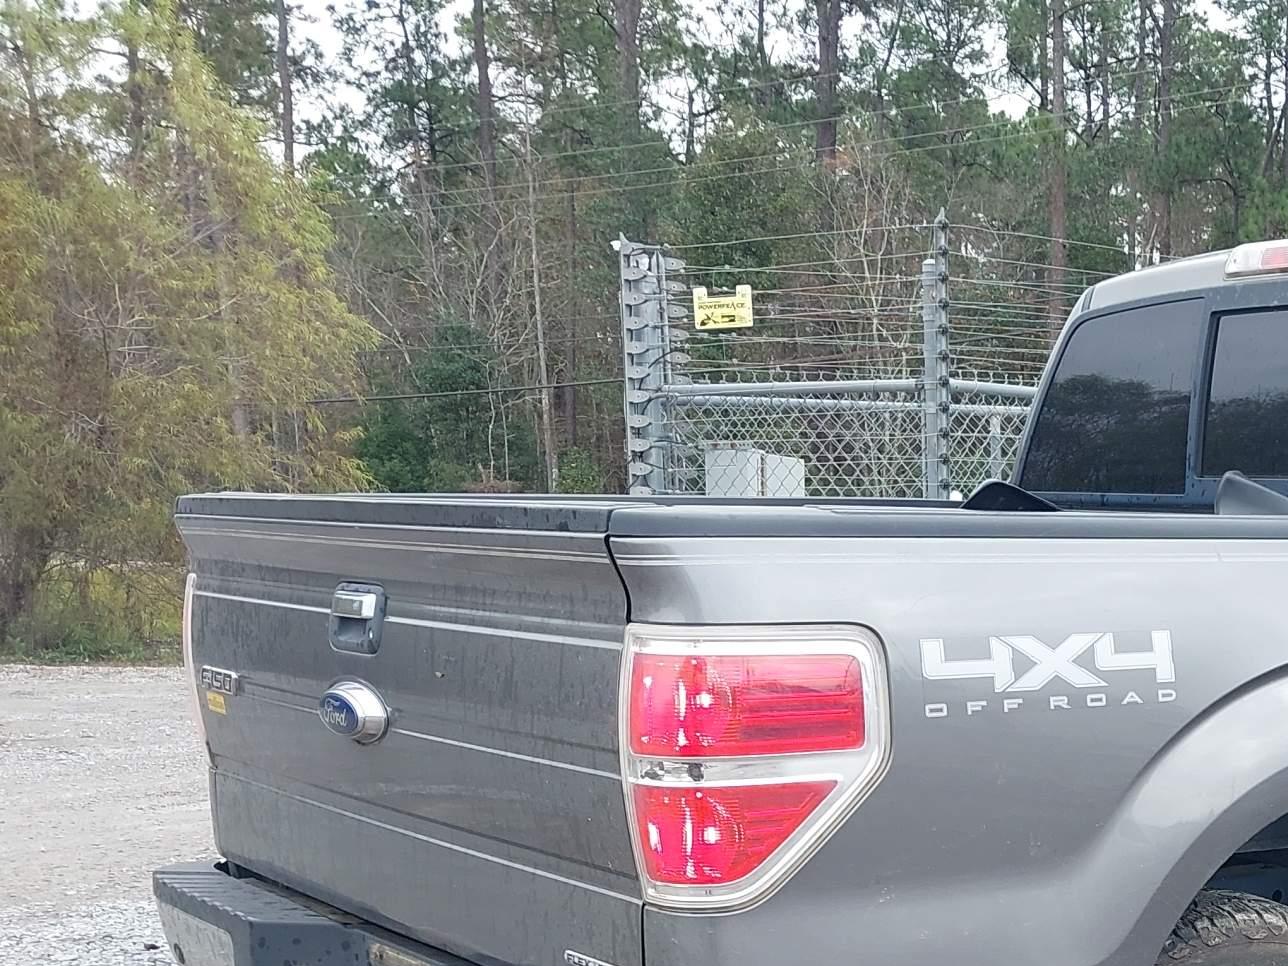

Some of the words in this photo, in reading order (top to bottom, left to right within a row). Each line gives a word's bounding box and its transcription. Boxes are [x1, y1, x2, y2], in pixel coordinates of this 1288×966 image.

[323, 699, 347, 726] Ford
[925, 699, 1024, 718] OFF
[1049, 689, 1177, 710] ROAD
